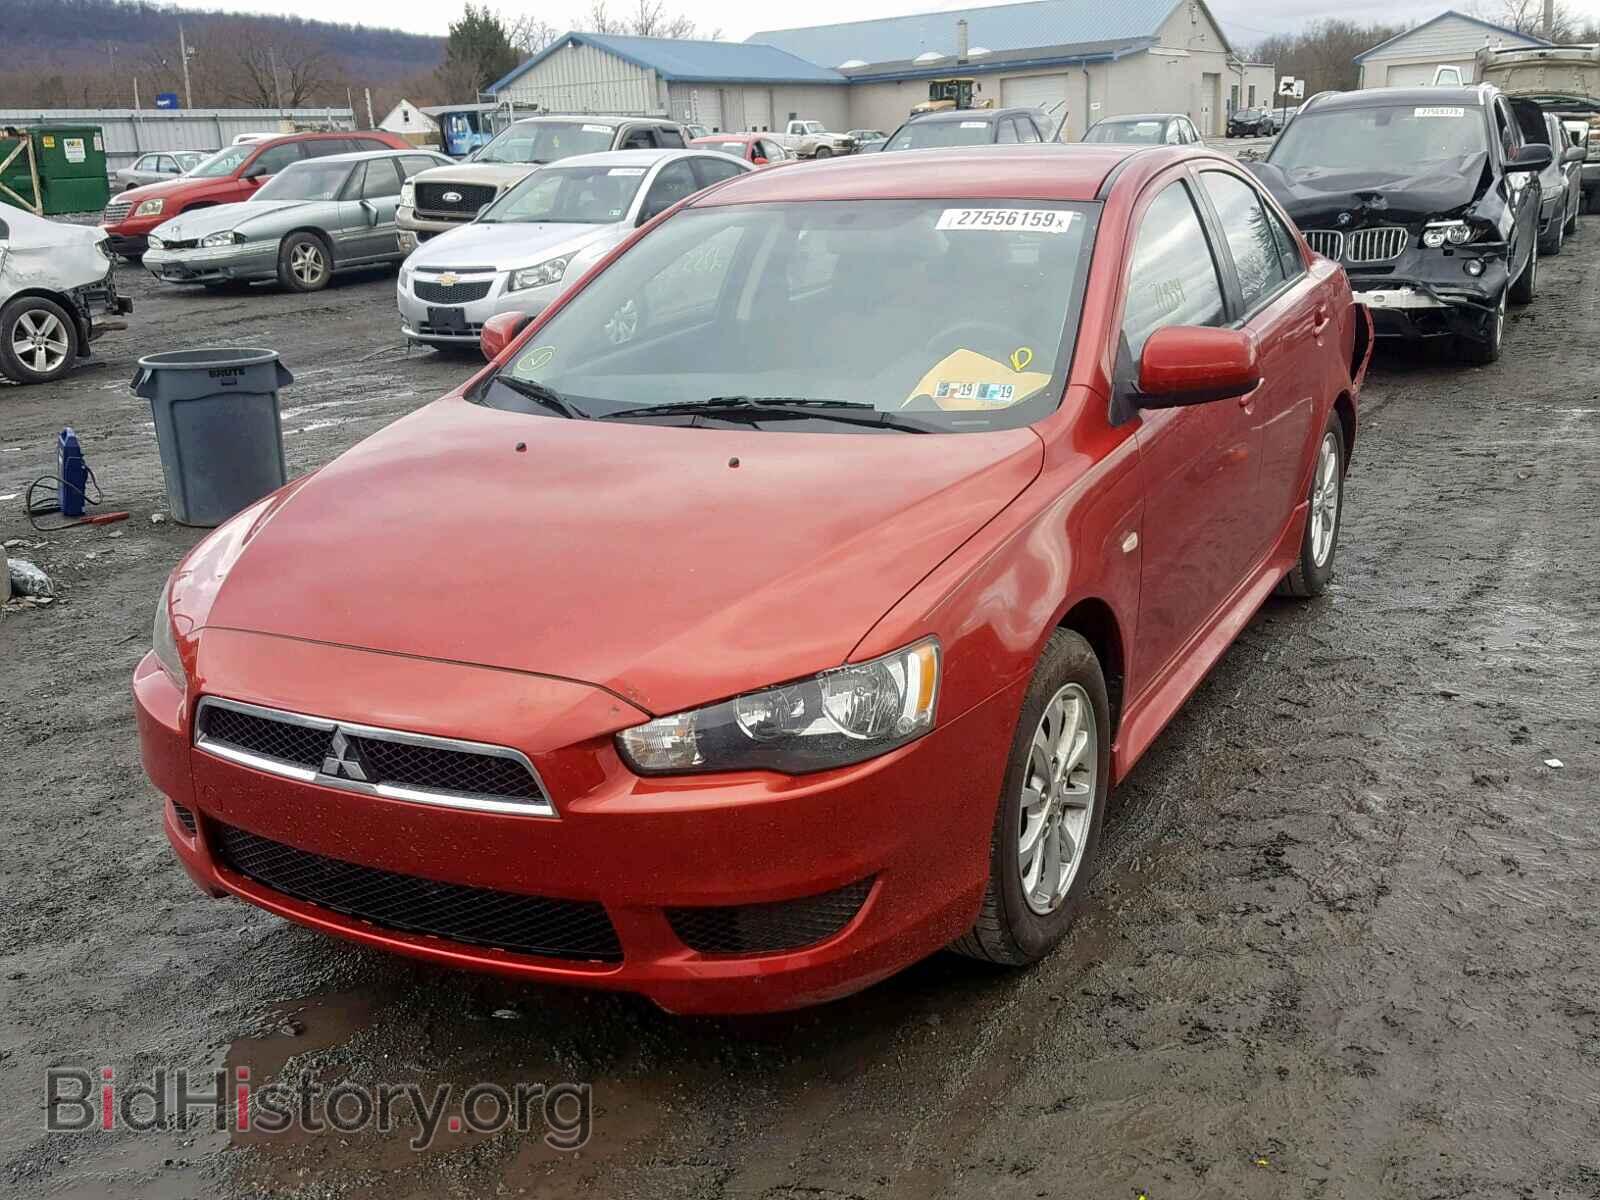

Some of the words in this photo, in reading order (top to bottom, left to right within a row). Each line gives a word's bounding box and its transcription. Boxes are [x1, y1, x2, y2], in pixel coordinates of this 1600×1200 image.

[957, 210, 1056, 227] 27556159
[208, 367, 246, 378] BRUTE
[960, 383, 973, 396] 19
[1000, 385, 1013, 398] 19
